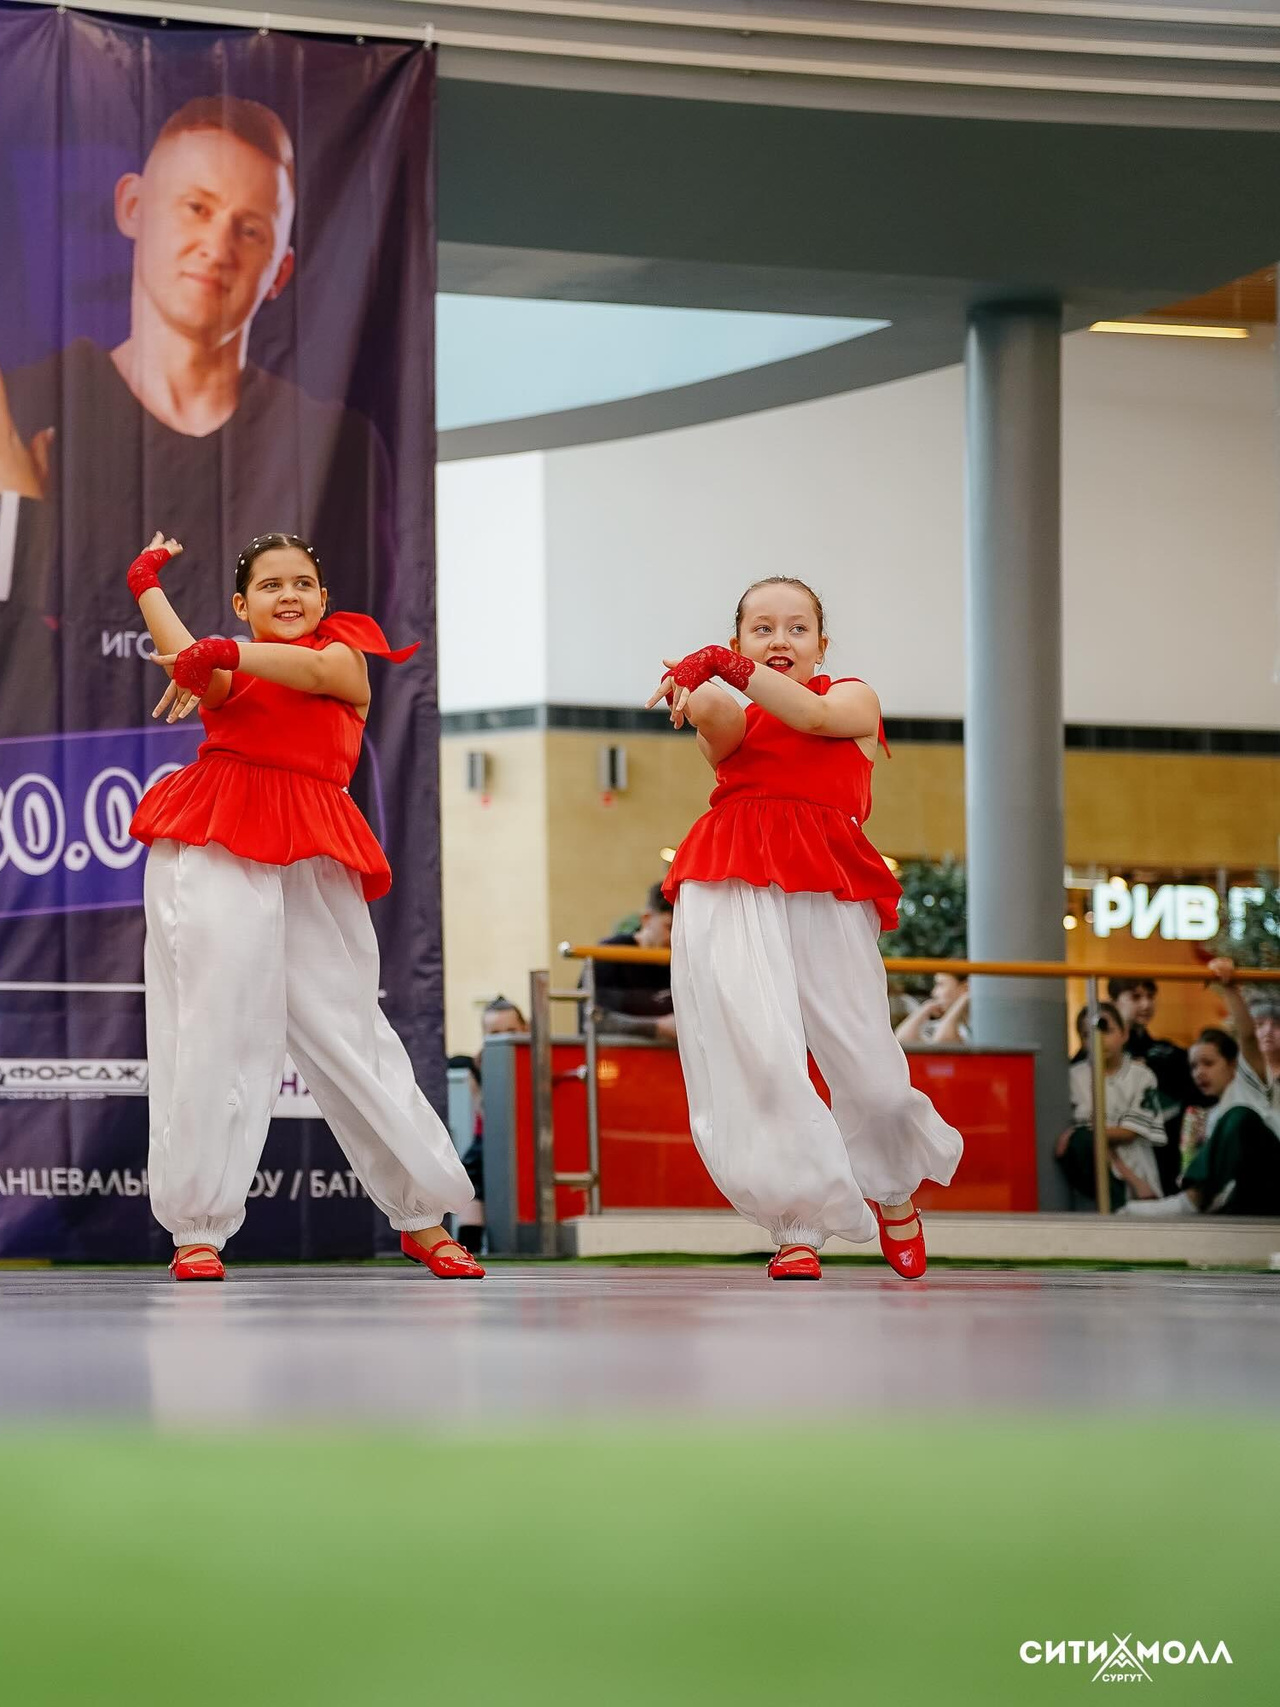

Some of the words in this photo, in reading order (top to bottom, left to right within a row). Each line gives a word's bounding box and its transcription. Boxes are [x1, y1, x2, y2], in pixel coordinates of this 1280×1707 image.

[101, 630, 158, 661] ИГО
[1092, 883, 1220, 941] РИВ
[9, 1066, 140, 1081] ФОРСАЖ
